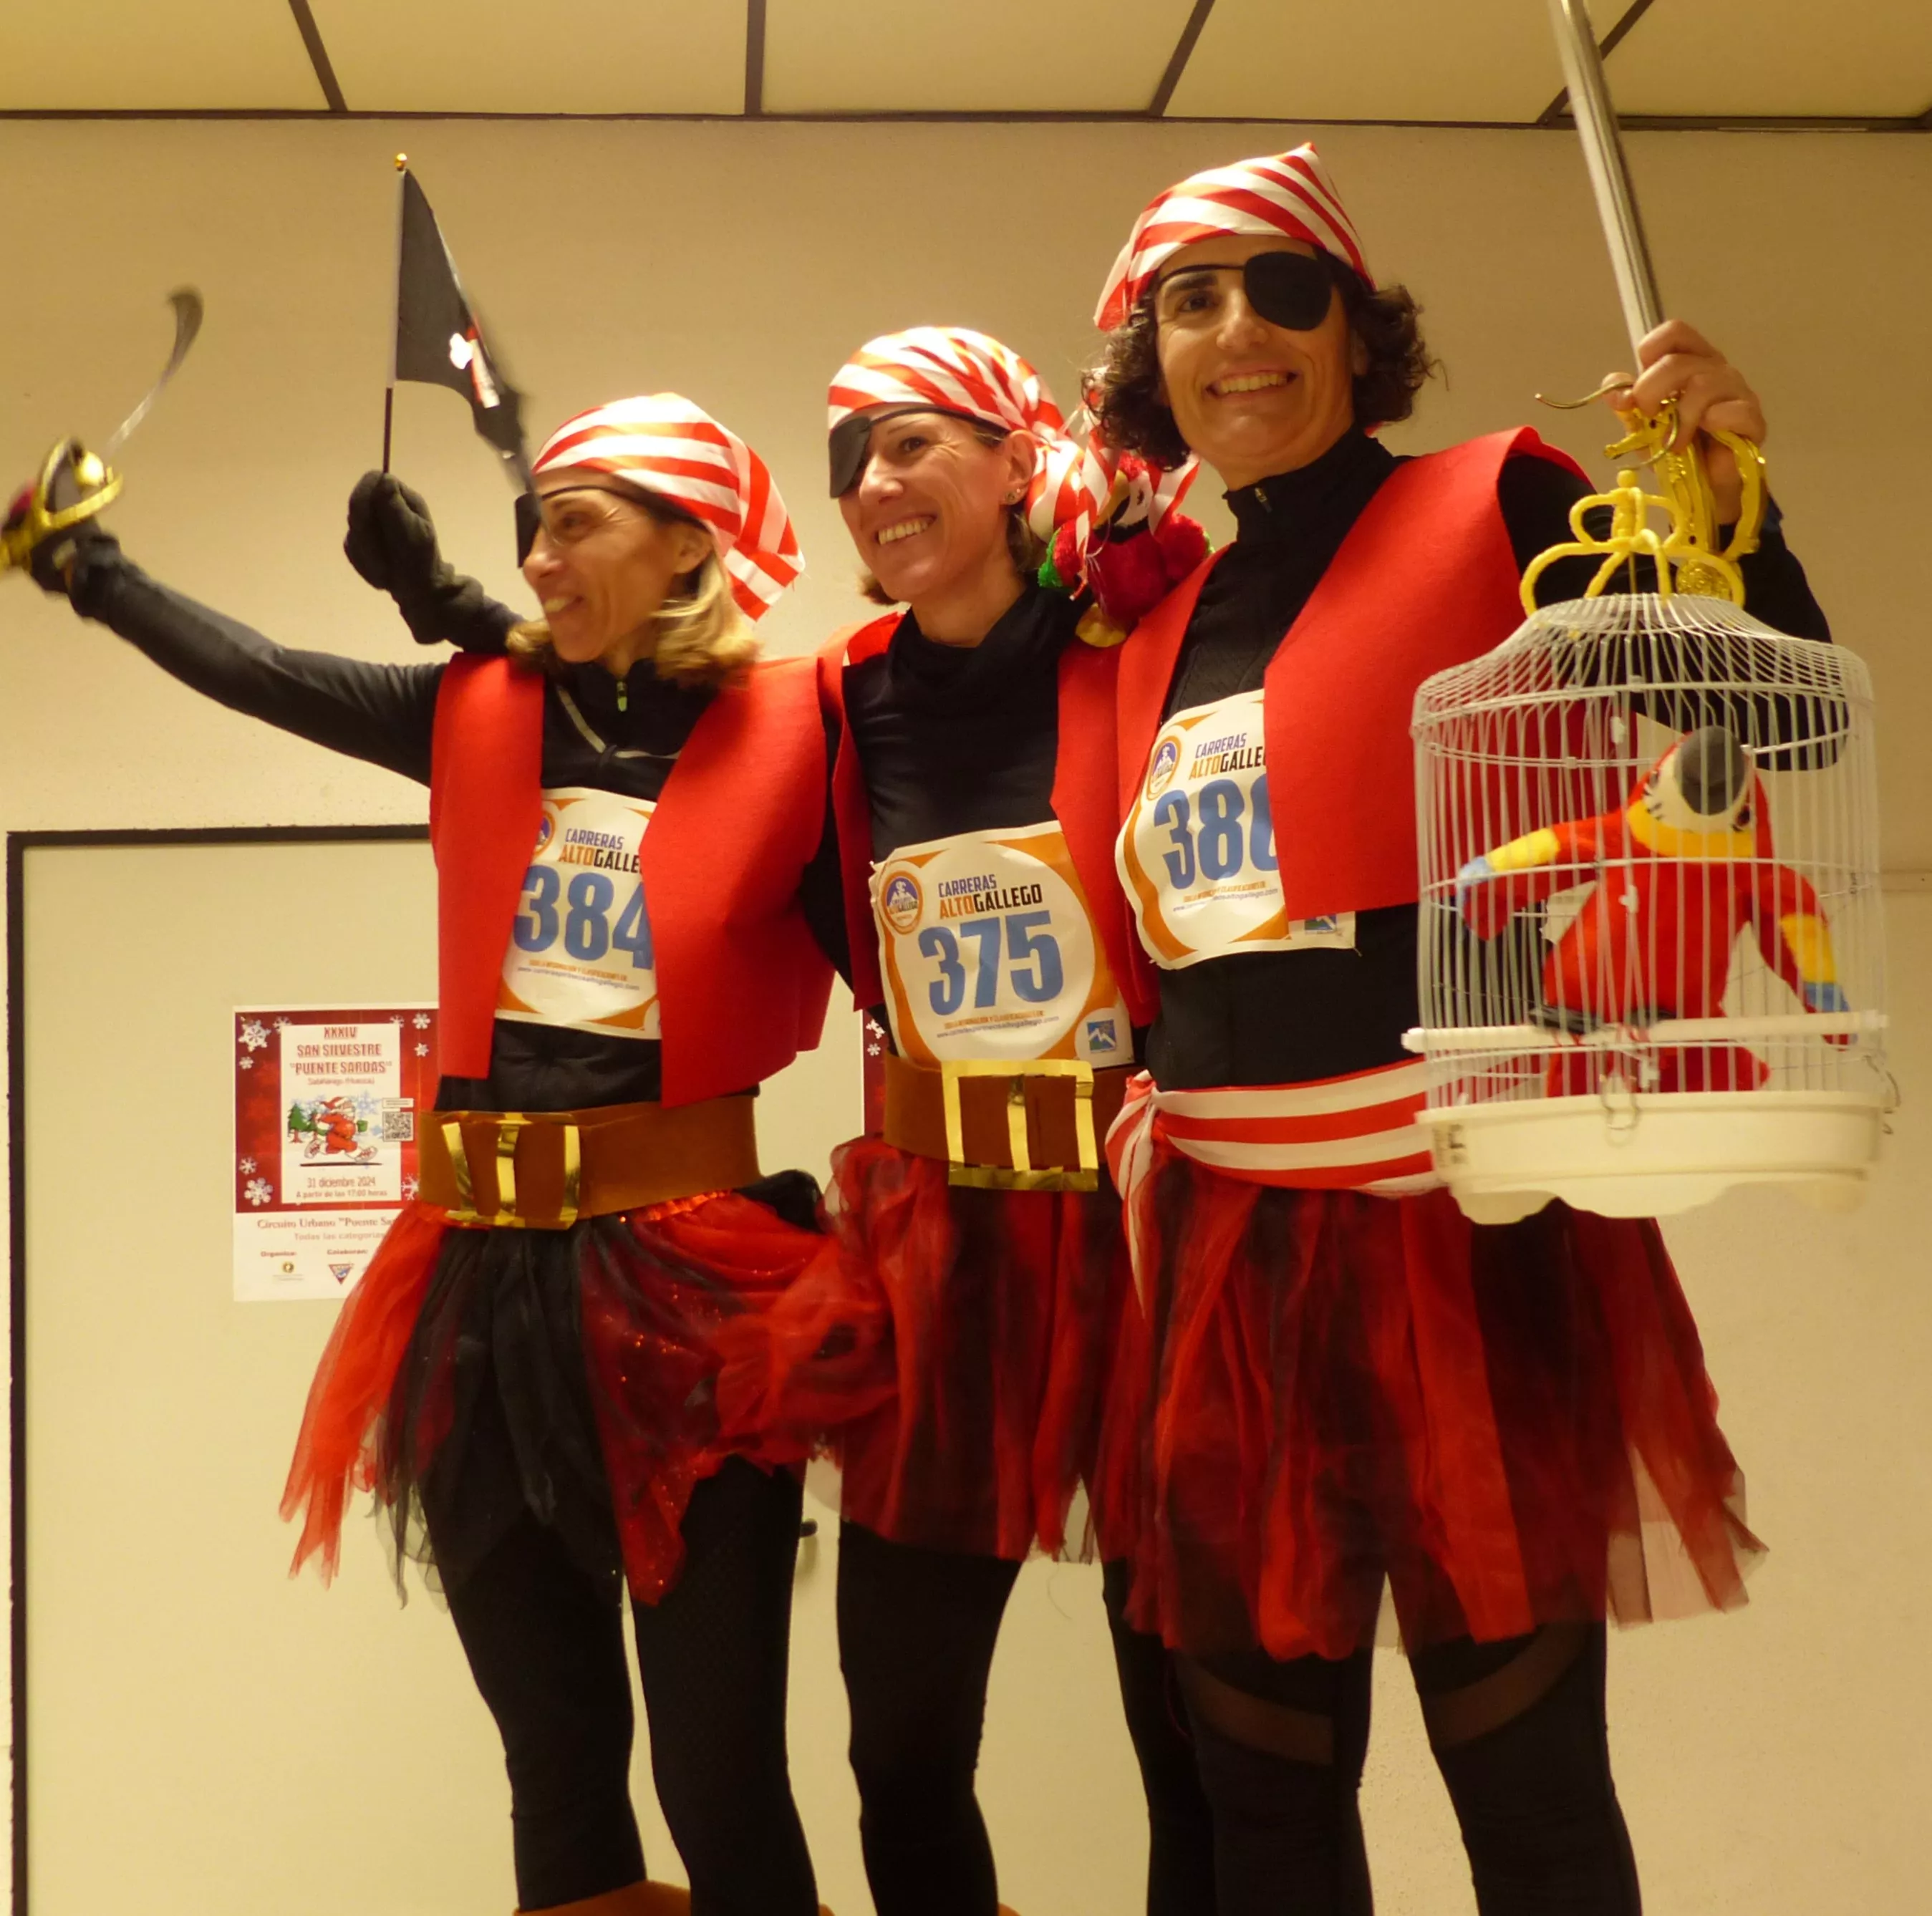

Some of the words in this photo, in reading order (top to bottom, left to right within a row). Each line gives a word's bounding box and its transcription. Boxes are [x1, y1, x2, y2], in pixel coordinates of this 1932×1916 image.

[1195, 732, 1247, 759] CARRERAS
[1189, 746, 1266, 780] ALTOGALLE
[566, 828, 624, 850] CARRERAS
[559, 844, 642, 874] ALTOGALLE
[938, 874, 997, 898] CARRERAS
[939, 884, 1043, 919] ALTOGALLEGO
[513, 865, 654, 970] 384
[918, 910, 1063, 1016] 375
[324, 1026, 357, 1039] XXXIV
[296, 1044, 319, 1058] SAN
[322, 1043, 382, 1058] SILVESTRE
[290, 1061, 338, 1075] "PUENTE
[307, 1177, 316, 1189] 31
[319, 1176, 355, 1188] diciembre
[357, 1175, 376, 1187] 2024
[257, 1219, 296, 1229] Circuito
[299, 1217, 336, 1228] Urbano
